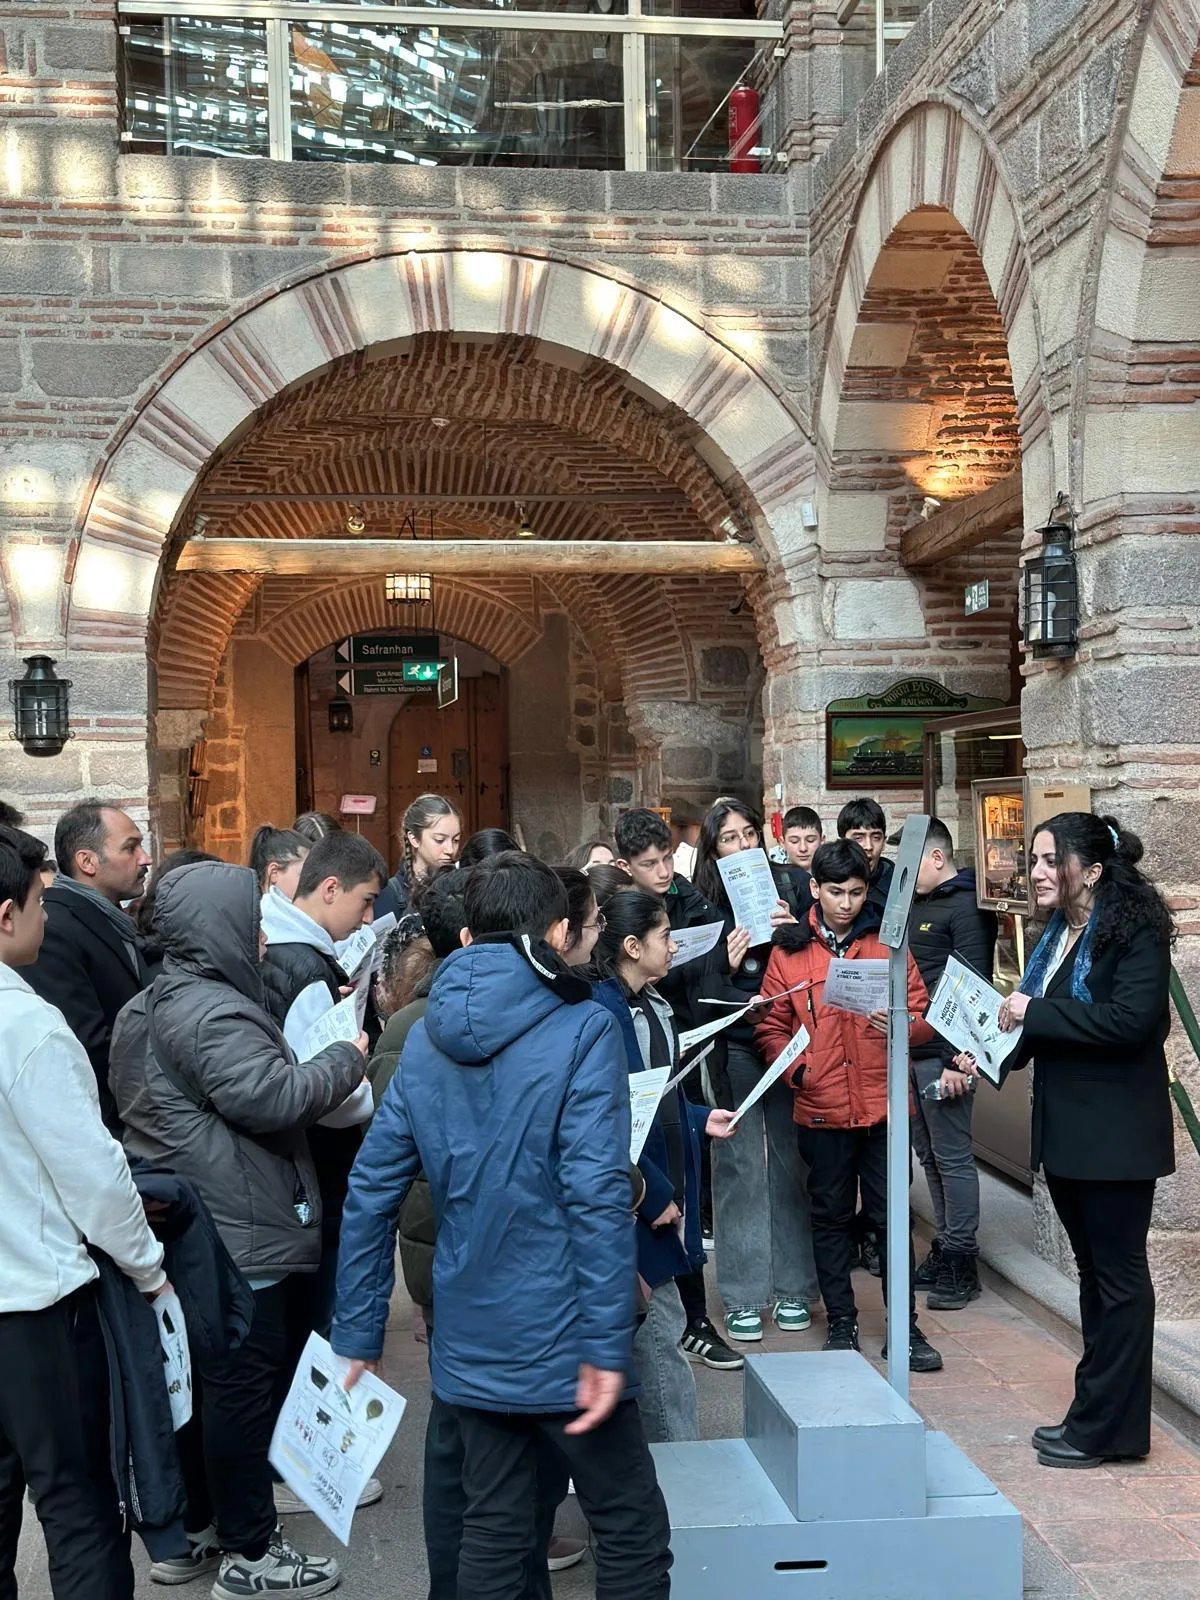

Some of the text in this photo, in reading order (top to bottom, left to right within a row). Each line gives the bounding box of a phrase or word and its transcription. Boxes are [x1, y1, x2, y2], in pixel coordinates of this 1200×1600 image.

[362, 644, 414, 655] Safranhan
[884, 681, 951, 705] NORTH EASTERN
[900, 698, 935, 706] RAILWAY
